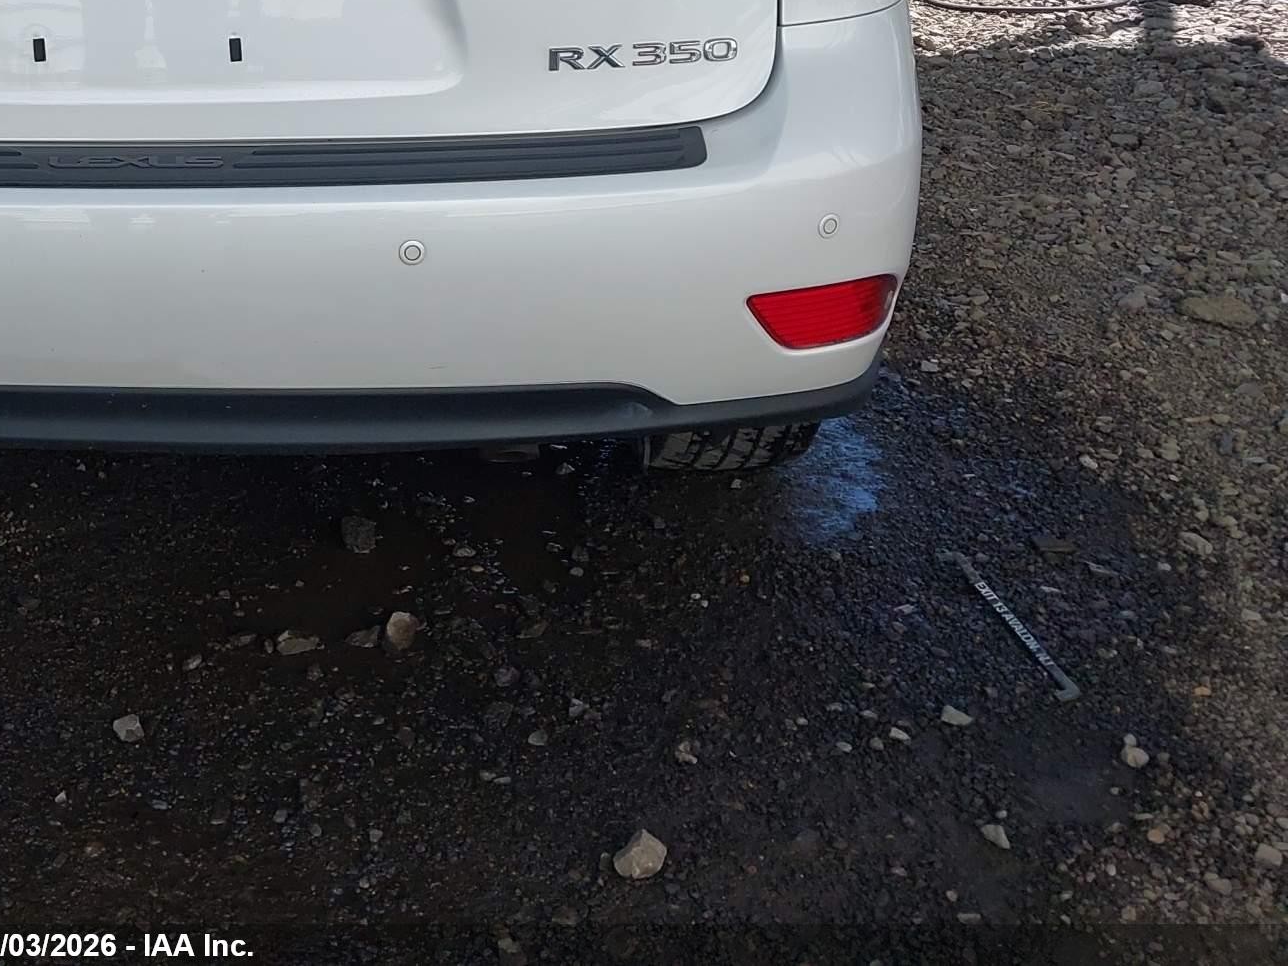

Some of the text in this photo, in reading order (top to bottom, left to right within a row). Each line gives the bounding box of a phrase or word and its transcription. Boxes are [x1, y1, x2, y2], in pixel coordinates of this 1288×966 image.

[548, 37, 738, 72] RX 350
[47, 155, 225, 170] LEXUS
